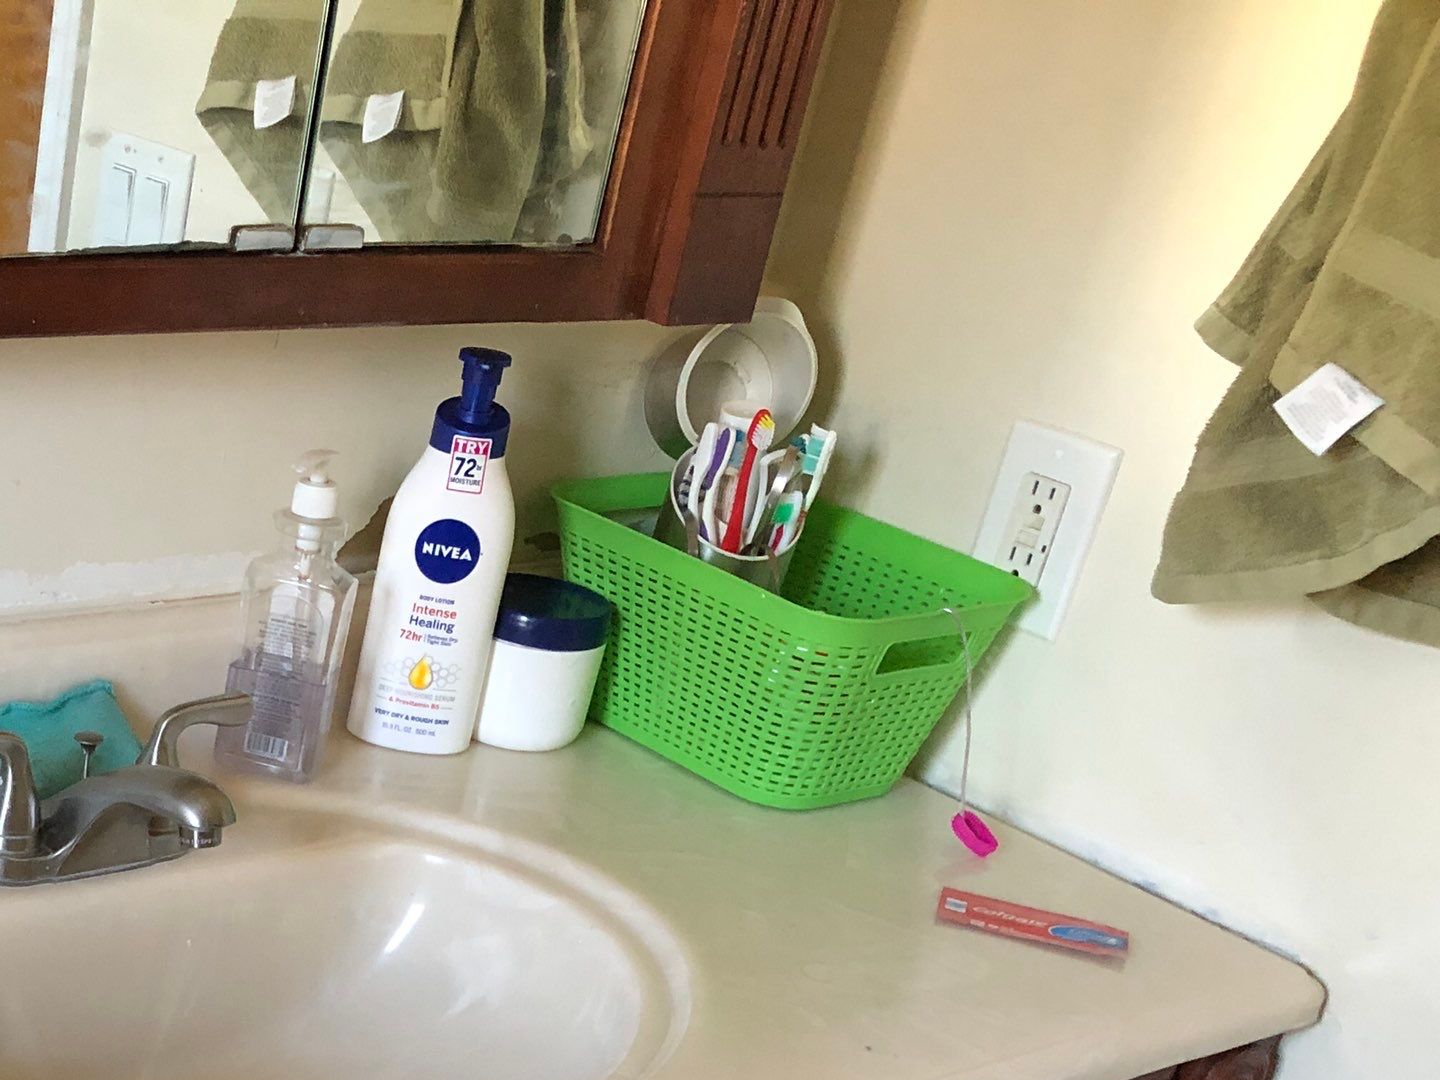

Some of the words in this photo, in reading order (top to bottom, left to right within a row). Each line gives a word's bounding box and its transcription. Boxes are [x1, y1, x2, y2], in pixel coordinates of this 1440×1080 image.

[456, 440, 488, 455] TRY
[450, 477, 481, 487] MOISTURE
[422, 541, 472, 561] NIVEA
[419, 594, 434, 603] BODY
[435, 596, 455, 605] LOTION
[412, 603, 457, 620] Intense
[409, 615, 455, 634] Healing
[400, 628, 423, 642] 72hr
[375, 707, 389, 716] VERY
[411, 716, 433, 724] ROUGH
